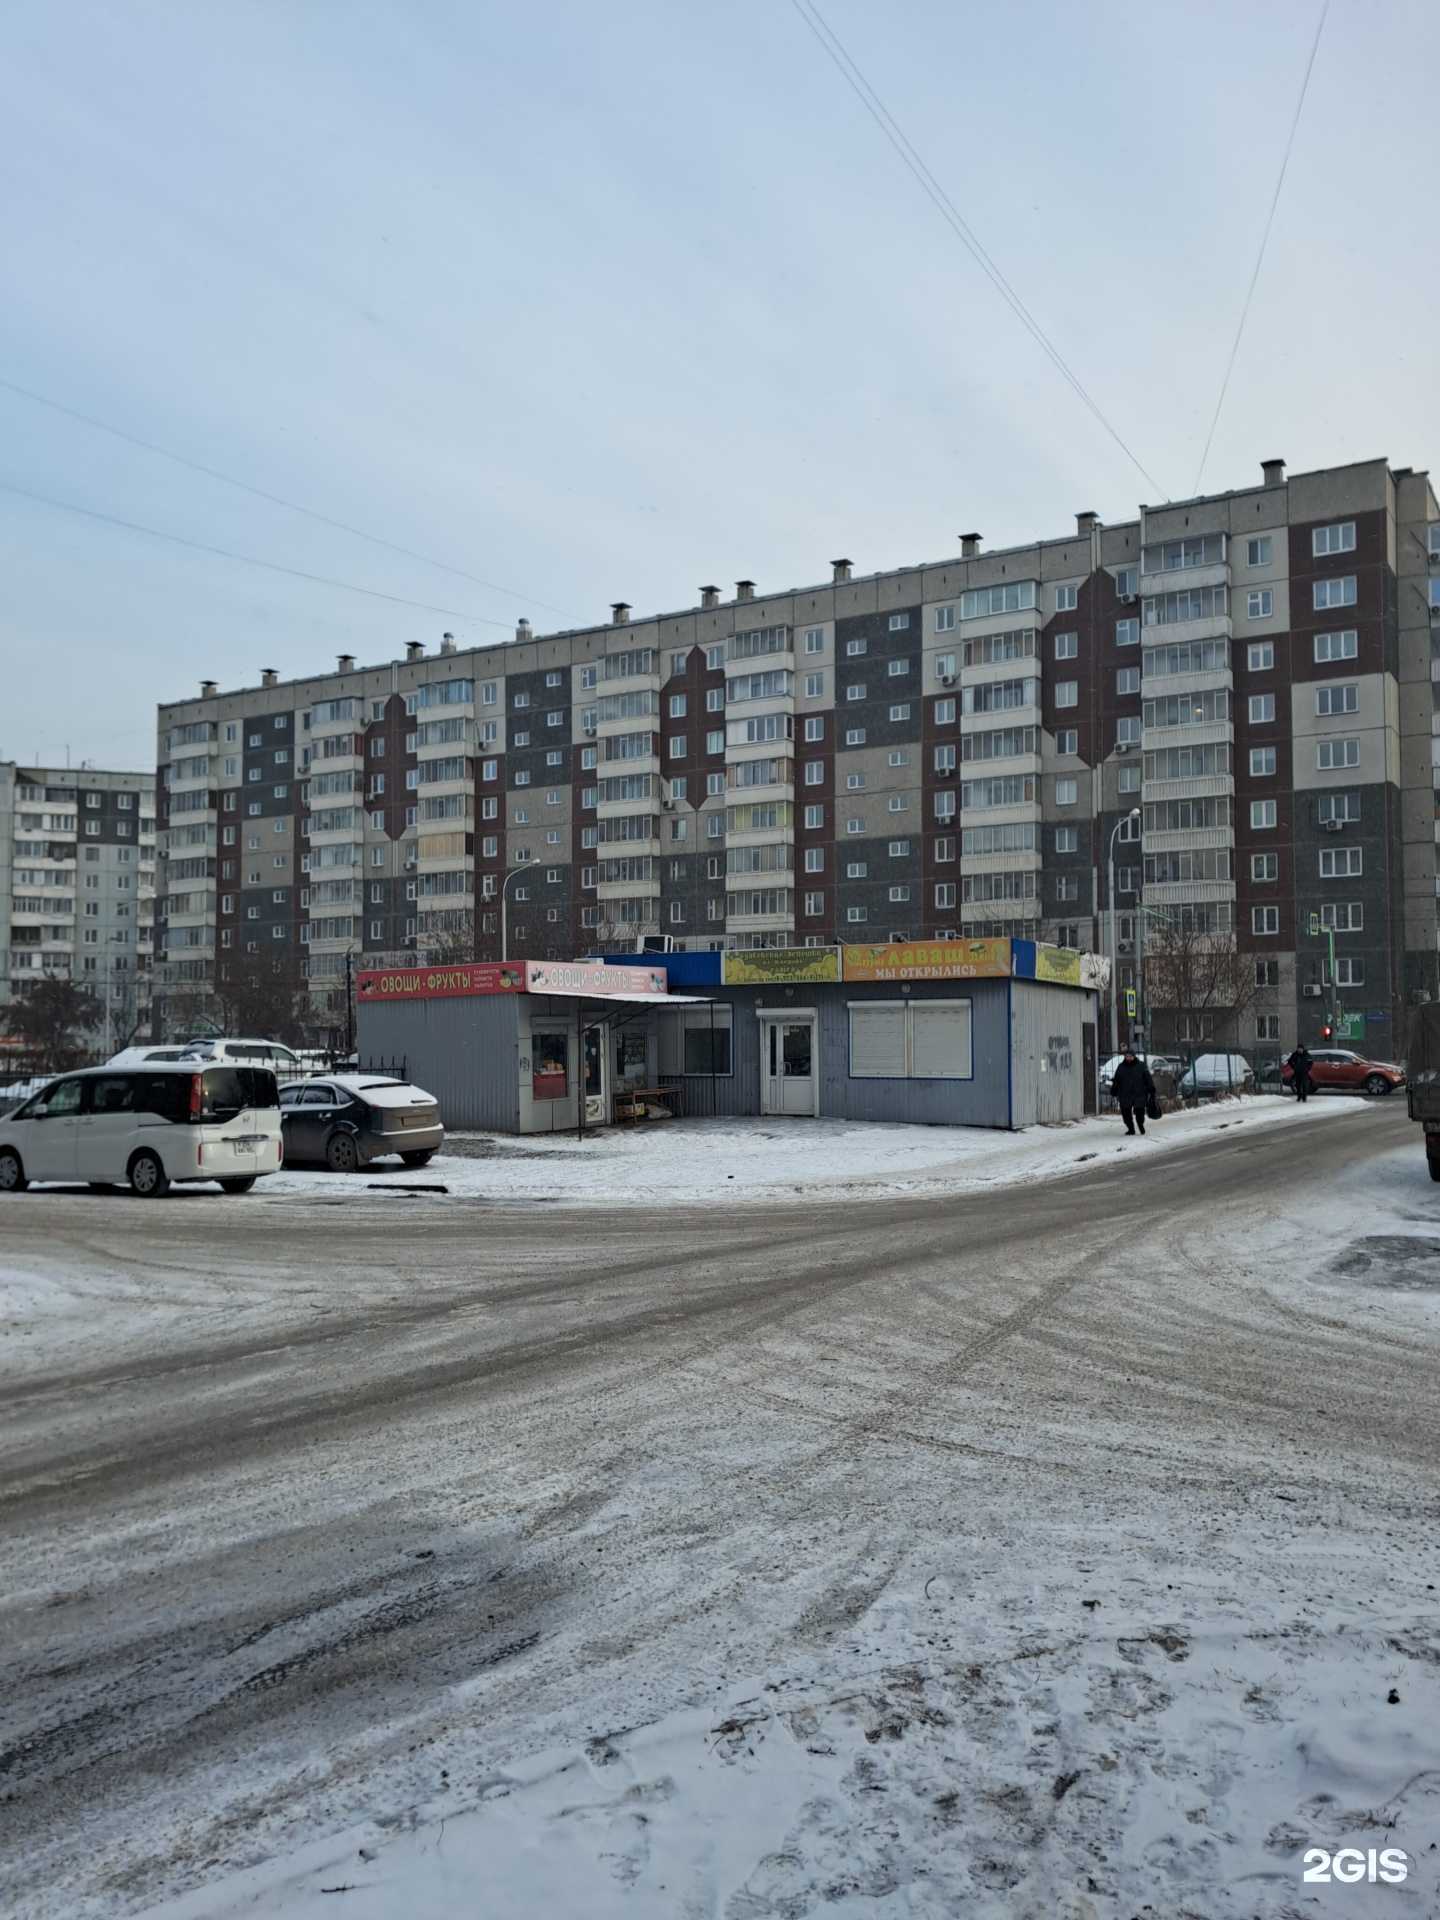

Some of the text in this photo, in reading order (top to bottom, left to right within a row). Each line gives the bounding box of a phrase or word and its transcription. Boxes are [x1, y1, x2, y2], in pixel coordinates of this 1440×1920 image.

[380, 976, 421, 993] ОВОЩИ
[427, 971, 471, 991] ФРУКТЫ
[550, 967, 586, 989] ОВОЩИ
[875, 964, 977, 978] МЫ ОТКРЫЛИСЬ
